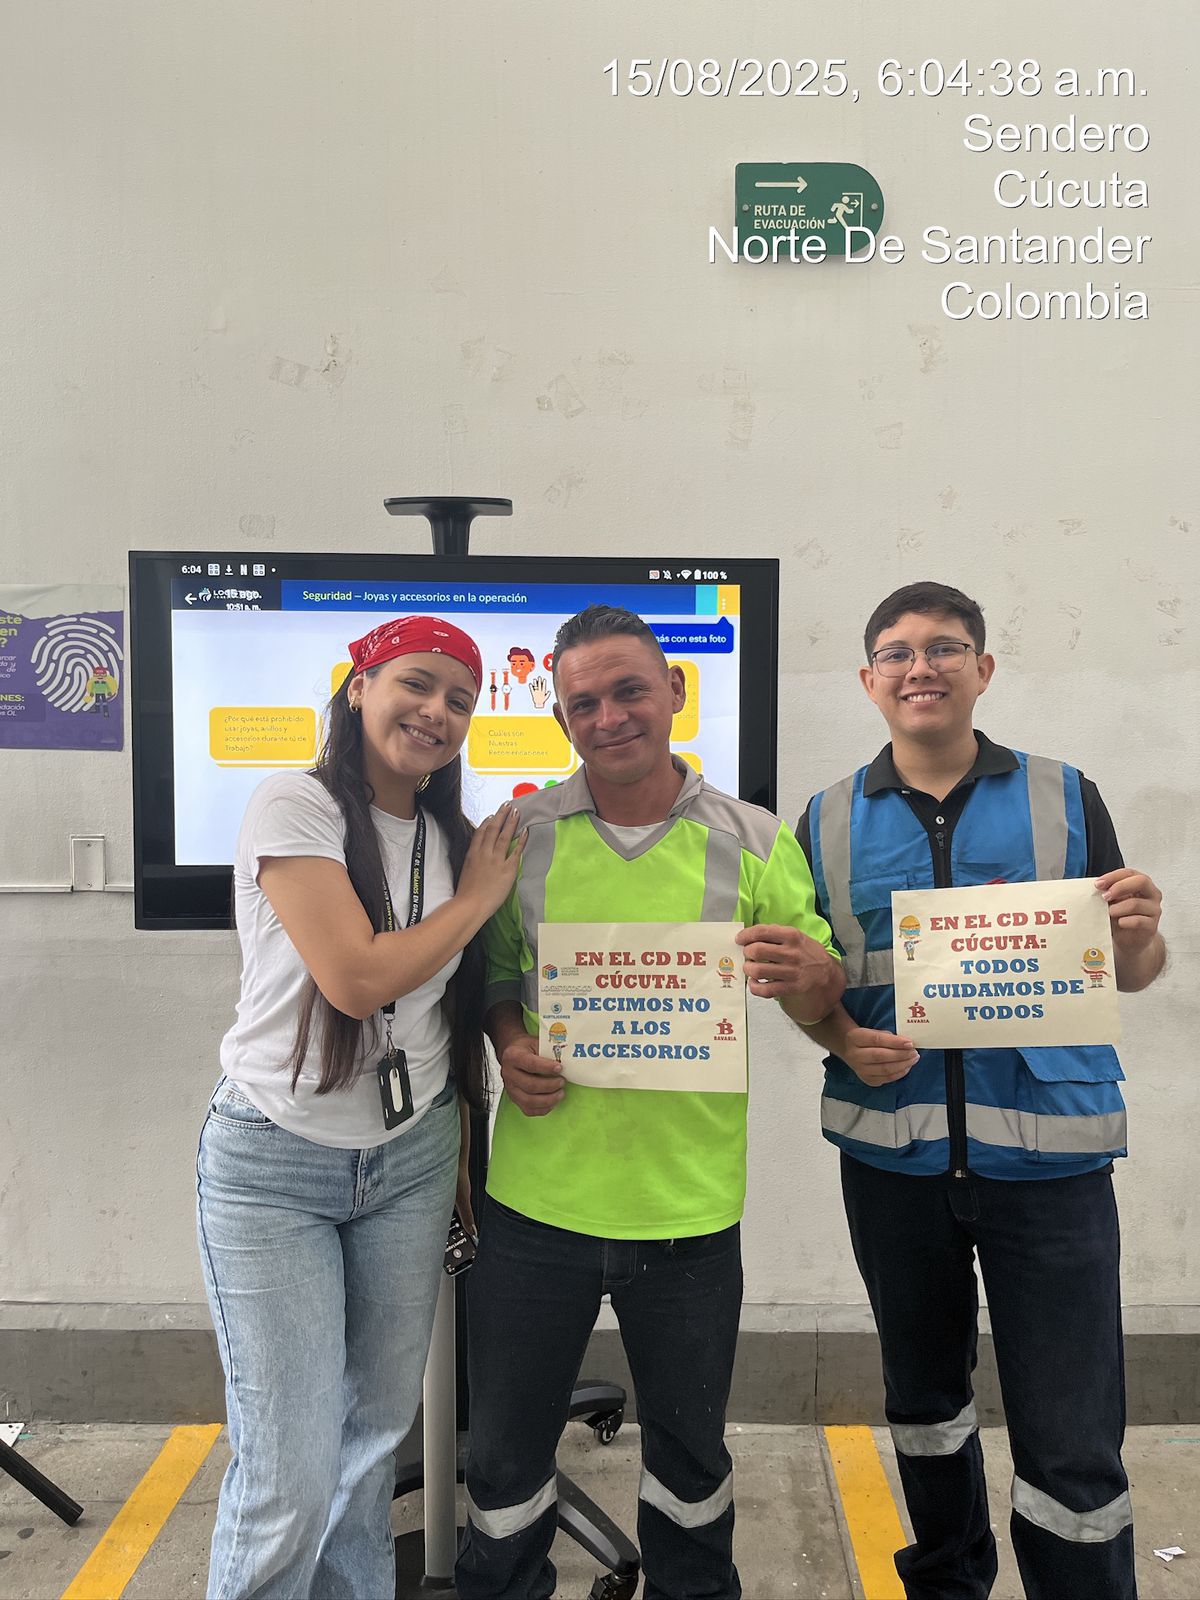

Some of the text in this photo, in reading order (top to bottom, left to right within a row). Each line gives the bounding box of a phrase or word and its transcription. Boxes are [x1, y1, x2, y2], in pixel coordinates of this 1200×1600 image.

[754, 205, 806, 217] RUTA DE
[753, 216, 825, 231] EVACUACIÓN
[181, 565, 202, 574] 6:04
[702, 571, 719, 580] 100
[302, 590, 352, 603] Seguridad
[363, 590, 389, 603] Joyas
[391, 593, 396, 603] y
[399, 591, 451, 603] accesorios
[453, 593, 465, 603] en
[468, 593, 477, 603] la
[479, 592, 527, 605] operación
[0, 614, 22, 625] ste
[689, 635, 707, 644] esta
[709, 634, 727, 644] foto
[0, 694, 25, 702] NES:
[270, 715, 305, 724] prohibido
[409, 903, 419, 928] GRAND
[930, 910, 1067, 931] EN EL CD DE
[950, 933, 1047, 953] CÚCUTA:
[575, 951, 707, 966] EN EL CD DE
[960, 957, 1040, 975] TODOS
[595, 970, 687, 989] CÚCUTA:
[923, 979, 1085, 999] CUIDAMOS DE
[572, 997, 711, 1013] DECIMOS NO
[964, 1004, 1044, 1021] TODOS
[611, 1020, 671, 1035] A LOS
[572, 1043, 711, 1060] ACCESORIOS
